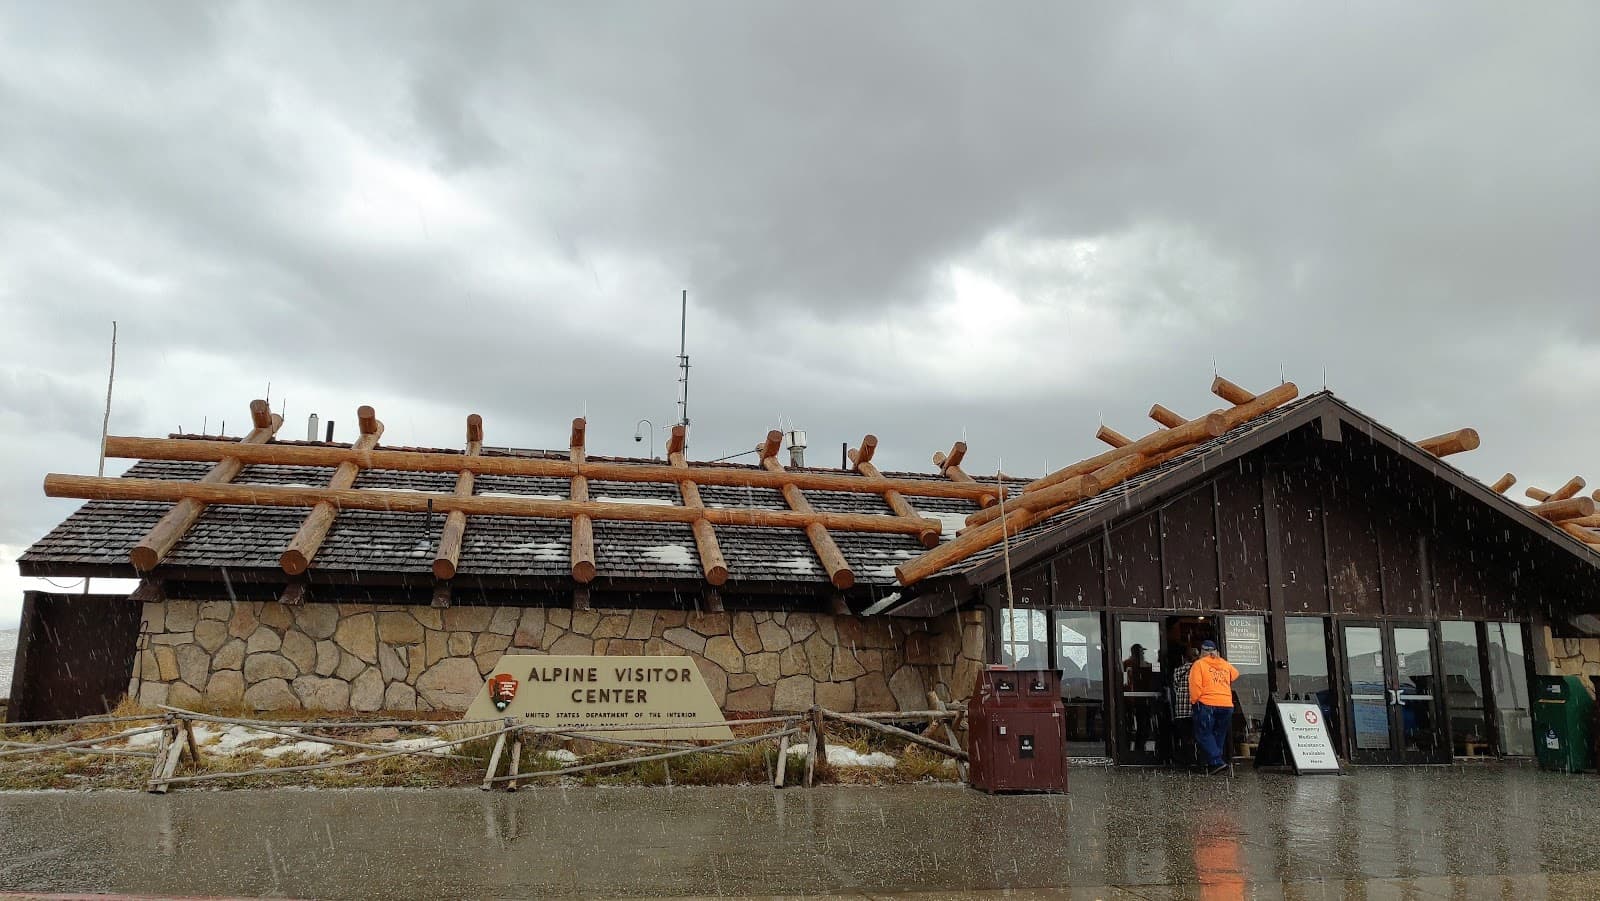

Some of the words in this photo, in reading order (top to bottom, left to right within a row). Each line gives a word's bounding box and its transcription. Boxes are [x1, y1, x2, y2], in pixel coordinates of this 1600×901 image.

[1021, 596, 1030, 604] 10
[1229, 619, 1251, 627] OPEN
[528, 667, 598, 682] ALPINE
[615, 667, 692, 683] VISITOR
[571, 688, 648, 704] CENTER
